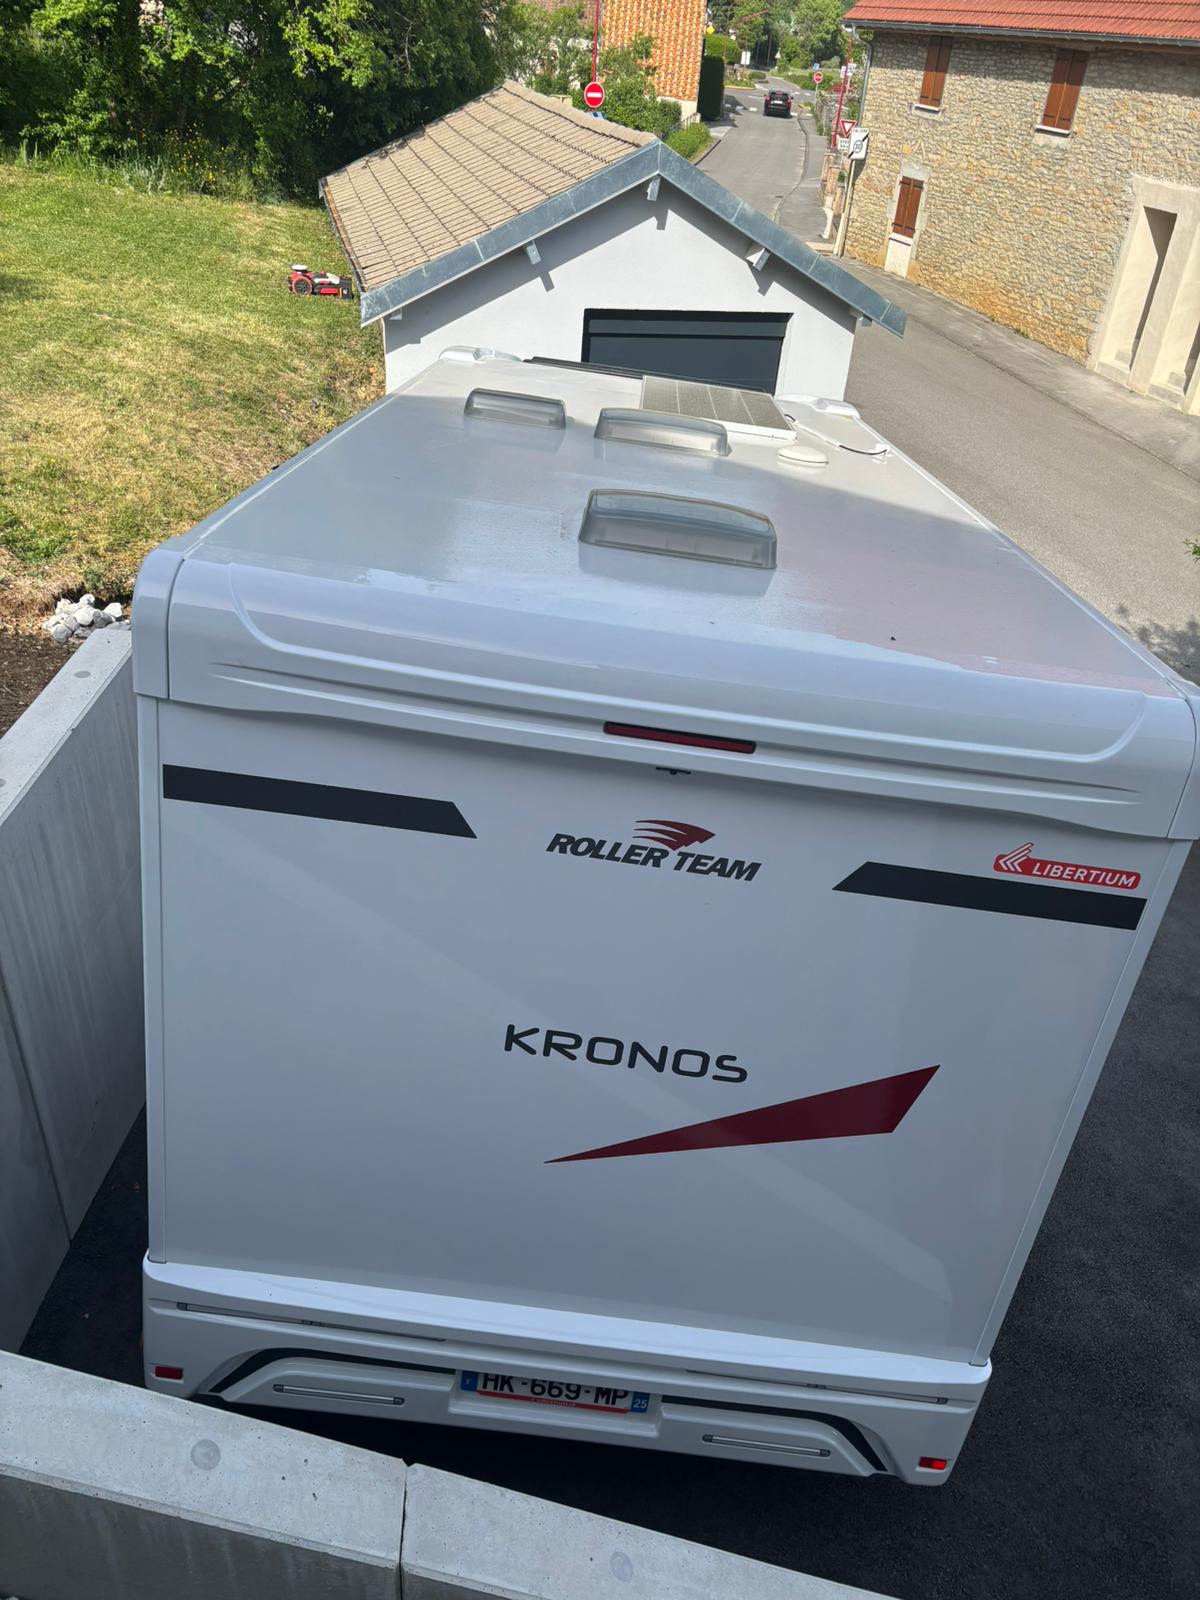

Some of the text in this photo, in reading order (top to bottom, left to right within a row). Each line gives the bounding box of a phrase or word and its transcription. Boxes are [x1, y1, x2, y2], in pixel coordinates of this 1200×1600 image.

[546, 833, 762, 882] ROLLER TEAM
[1031, 862, 1137, 888] LIBERTIUM
[504, 1024, 748, 1083] KRONOS
[632, 1398, 648, 1409] 25
